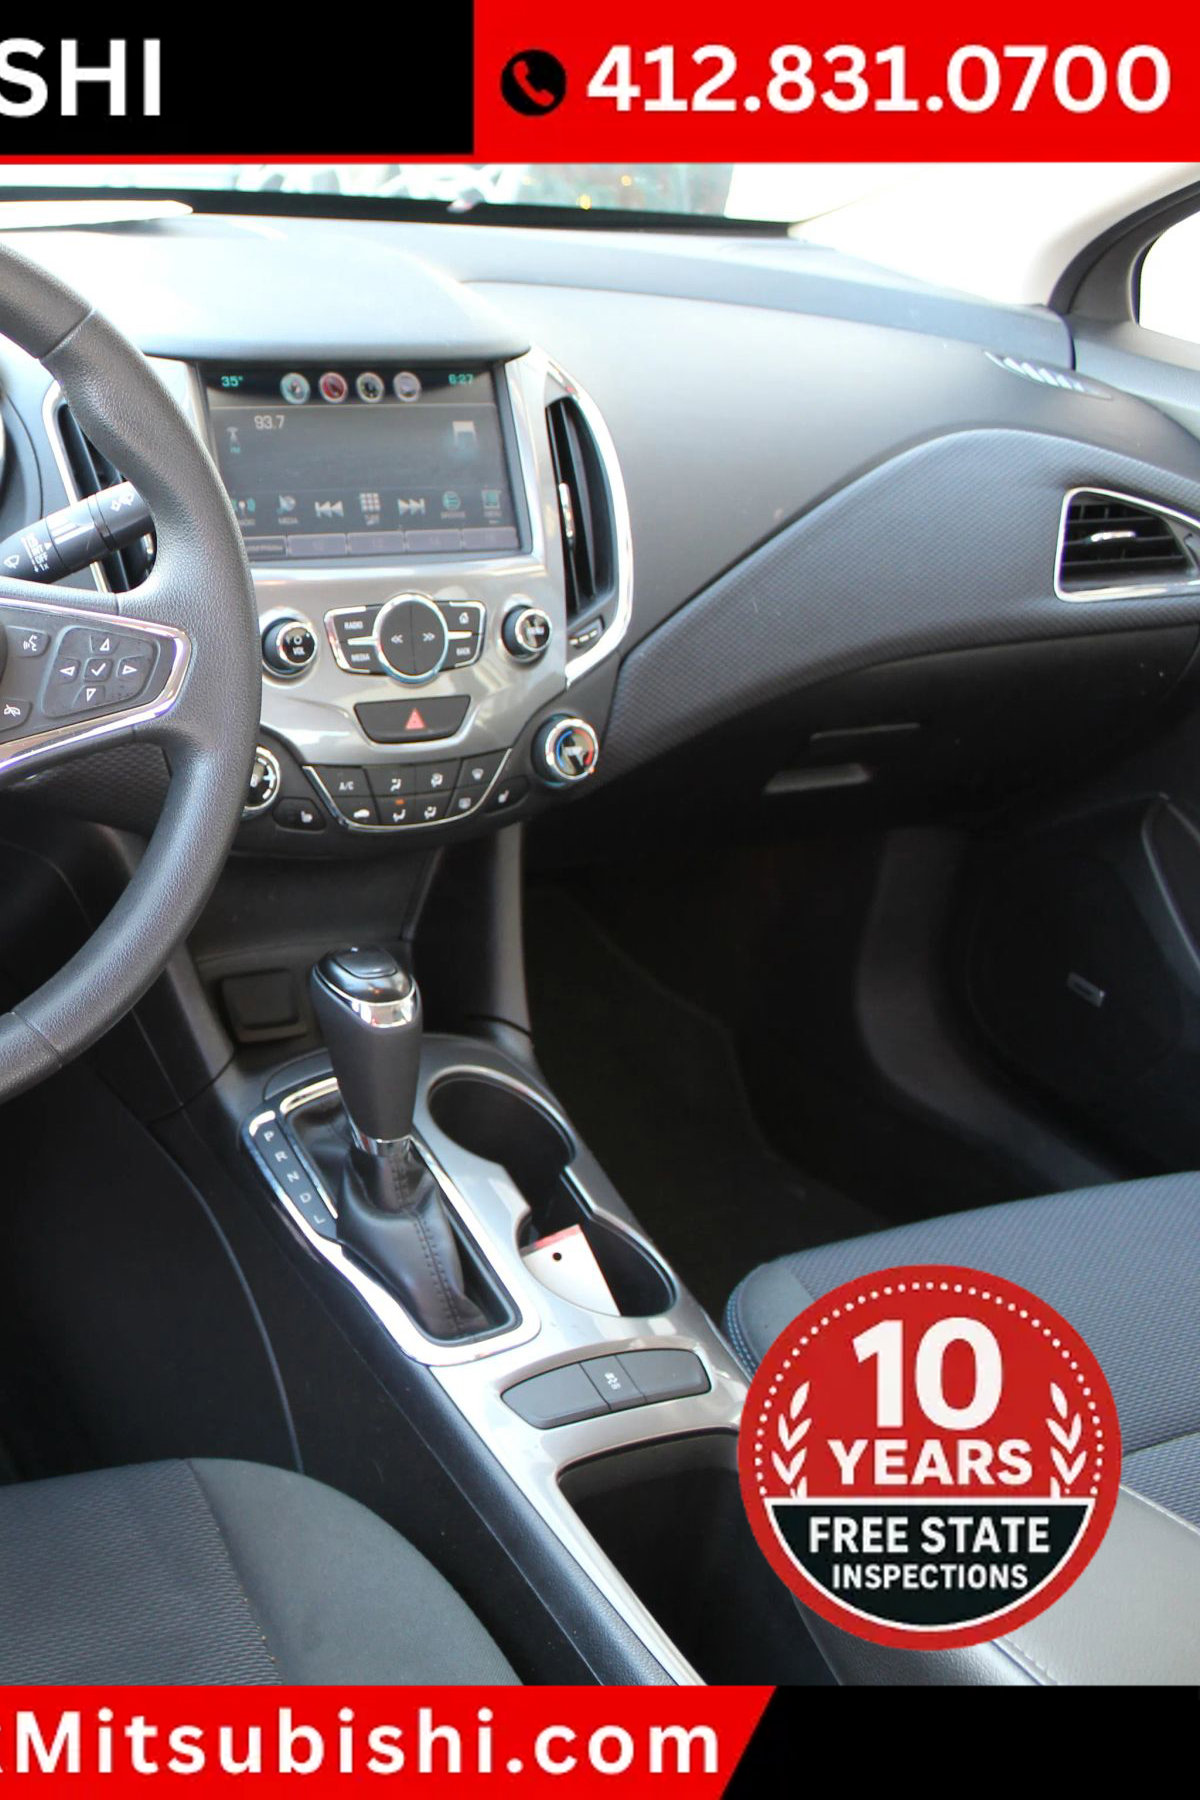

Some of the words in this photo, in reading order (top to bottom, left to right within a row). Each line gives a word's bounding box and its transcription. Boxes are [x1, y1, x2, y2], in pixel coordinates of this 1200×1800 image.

[254, 414, 285, 430] 93.7
[293, 646, 305, 656] VOL
[339, 781, 354, 791] A/C
[263, 1130, 275, 1142] P
[275, 1151, 288, 1162] R
[286, 1171, 299, 1182] N
[300, 1192, 311, 1203] D
[313, 1214, 325, 1224] L
